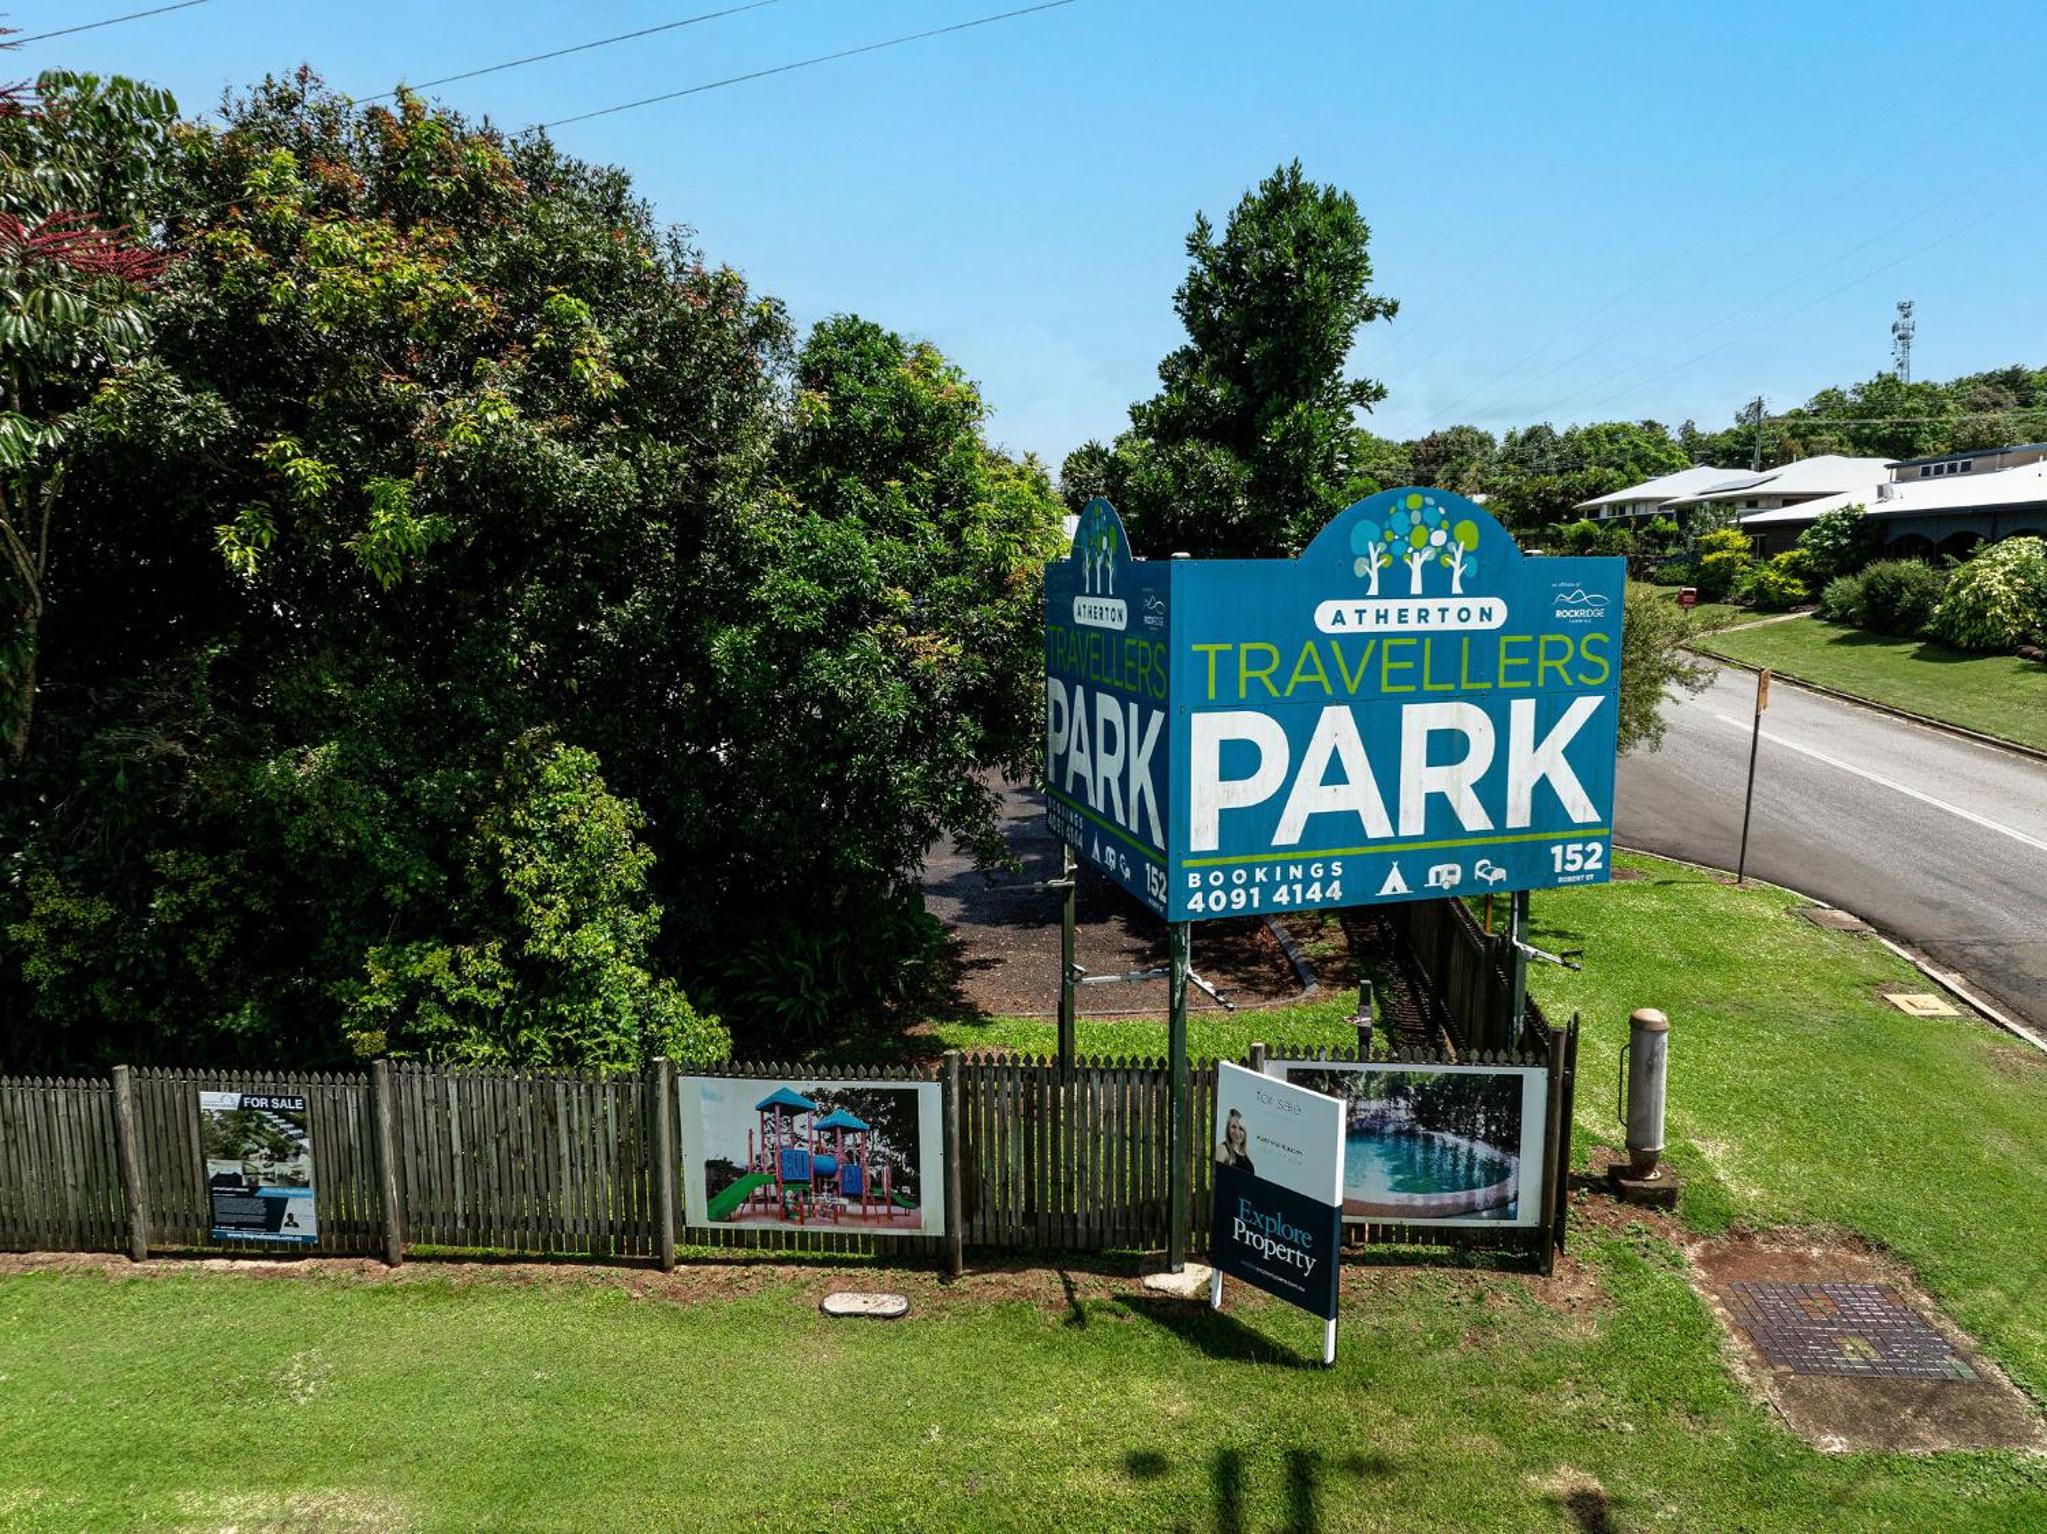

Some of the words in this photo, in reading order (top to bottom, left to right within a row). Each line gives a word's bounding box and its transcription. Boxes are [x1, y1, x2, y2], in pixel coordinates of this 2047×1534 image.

[1077, 603, 1123, 623] ATHERTON
[1331, 606, 1493, 626] ATHERTON
[1555, 608, 1605, 618] ROCKRIDGE
[1048, 625, 1167, 699] TRAVELLERS
[1192, 633, 1610, 699] TRAVELLERS
[1047, 676, 1165, 851] PARK
[1190, 695, 1606, 852] PARK
[1551, 841, 1603, 873] 152
[1146, 862, 1167, 904] 152
[1188, 861, 1343, 888] BOOKINGS
[1186, 887, 1260, 913] 4091
[1272, 880, 1343, 905] 4144
[243, 1097, 269, 1108] FOR
[271, 1098, 304, 1110] SALE
[1276, 1098, 1302, 1116] sale
[1238, 1196, 1313, 1248] Explore
[1232, 1216, 1317, 1277] Property
